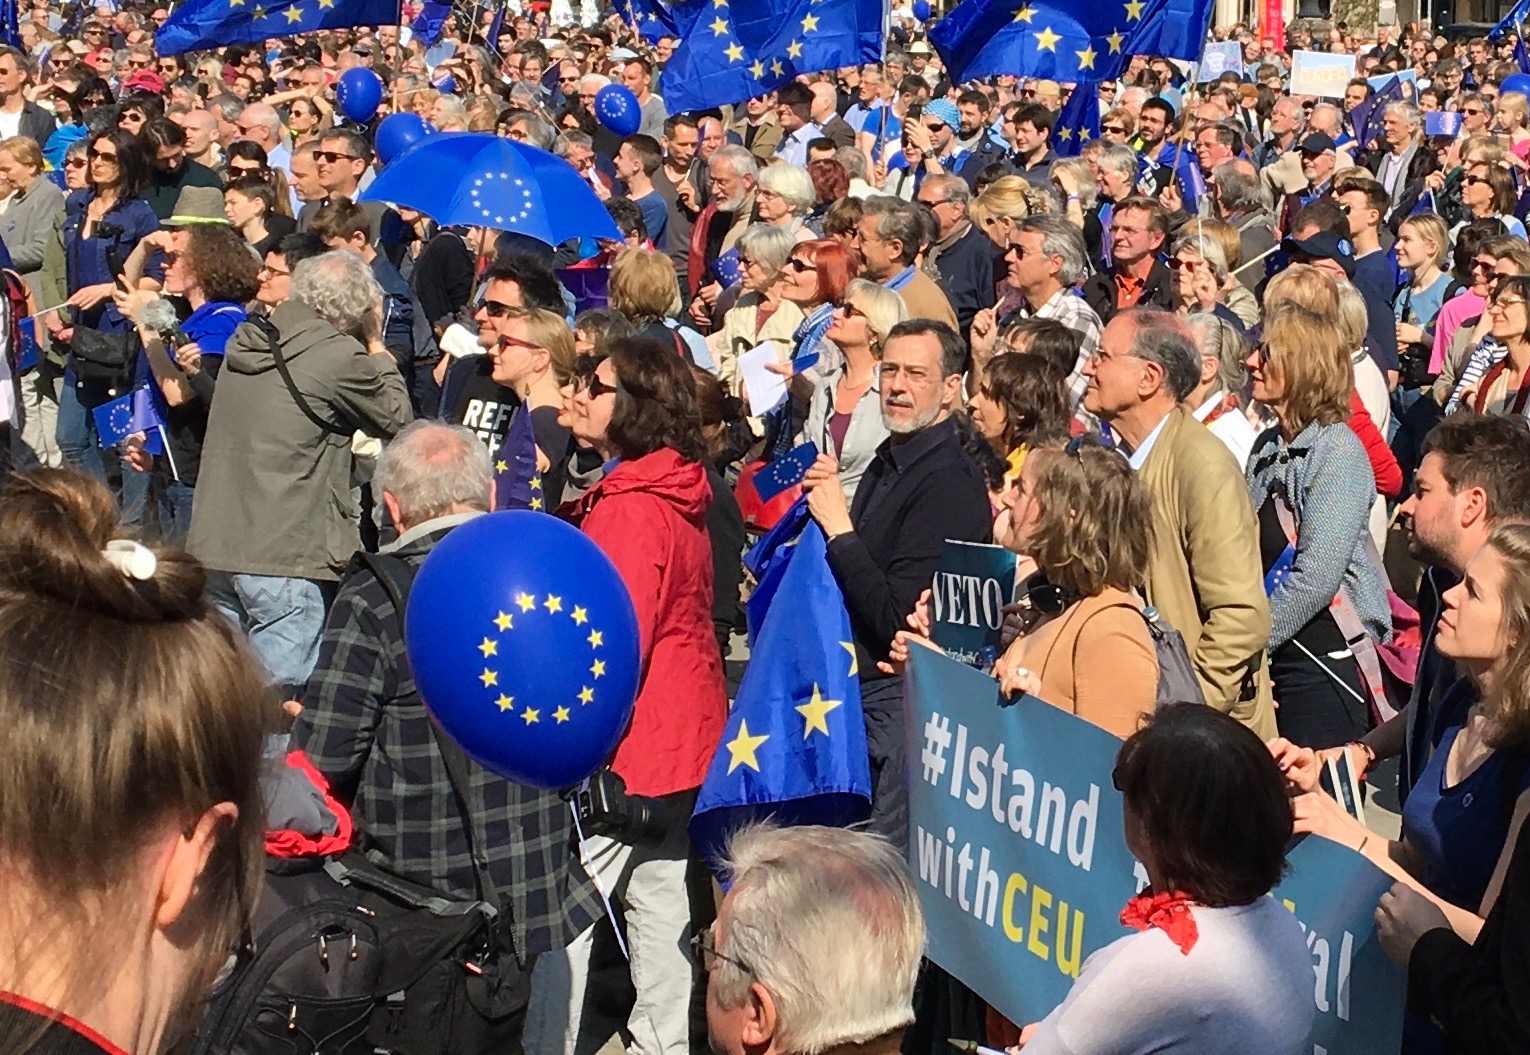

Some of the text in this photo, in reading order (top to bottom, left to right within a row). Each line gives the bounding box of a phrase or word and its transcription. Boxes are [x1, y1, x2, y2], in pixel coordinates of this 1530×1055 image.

[932, 571, 1004, 631] VETO
[921, 711, 1100, 873] #Istand
[917, 821, 1086, 980] withCEU
